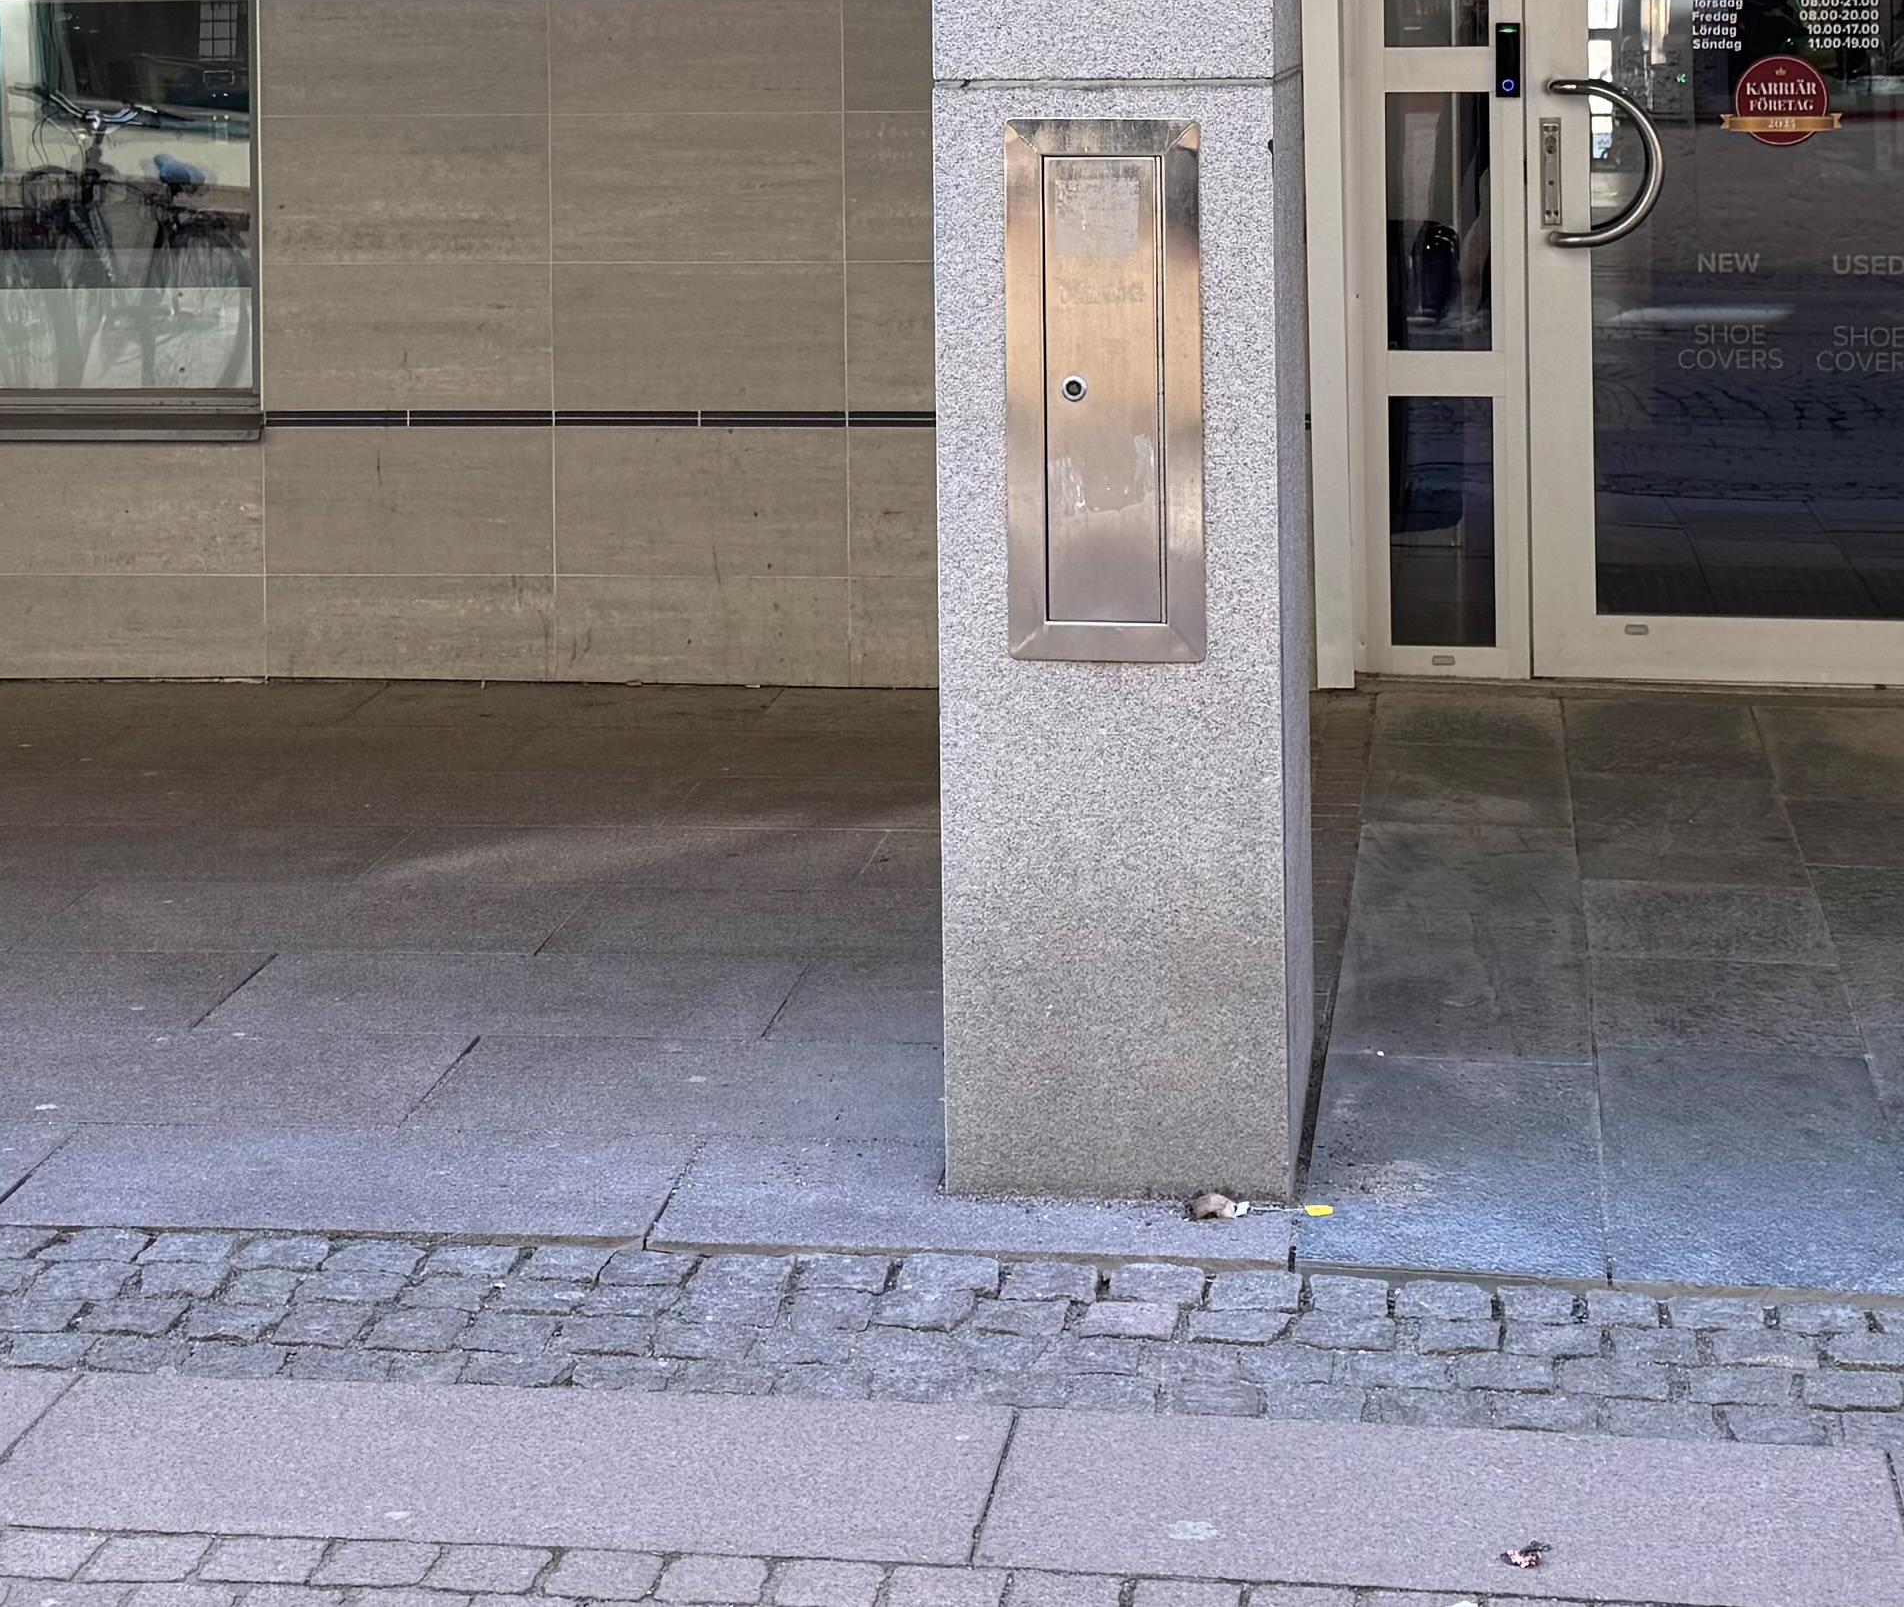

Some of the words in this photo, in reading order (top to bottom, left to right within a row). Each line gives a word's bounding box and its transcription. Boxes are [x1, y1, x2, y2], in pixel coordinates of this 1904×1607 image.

[1692, 11, 1738, 24] Fredag
[1692, 24, 1737, 38] Lördag
[1692, 37, 1743, 52] Söndag
[1746, 79, 1817, 96] KARRIÄR
[1749, 97, 1814, 112] FÖRETAG
[1697, 252, 1760, 274] NEW
[1694, 324, 1766, 345] SHOE
[1678, 347, 1784, 371] COVERS
